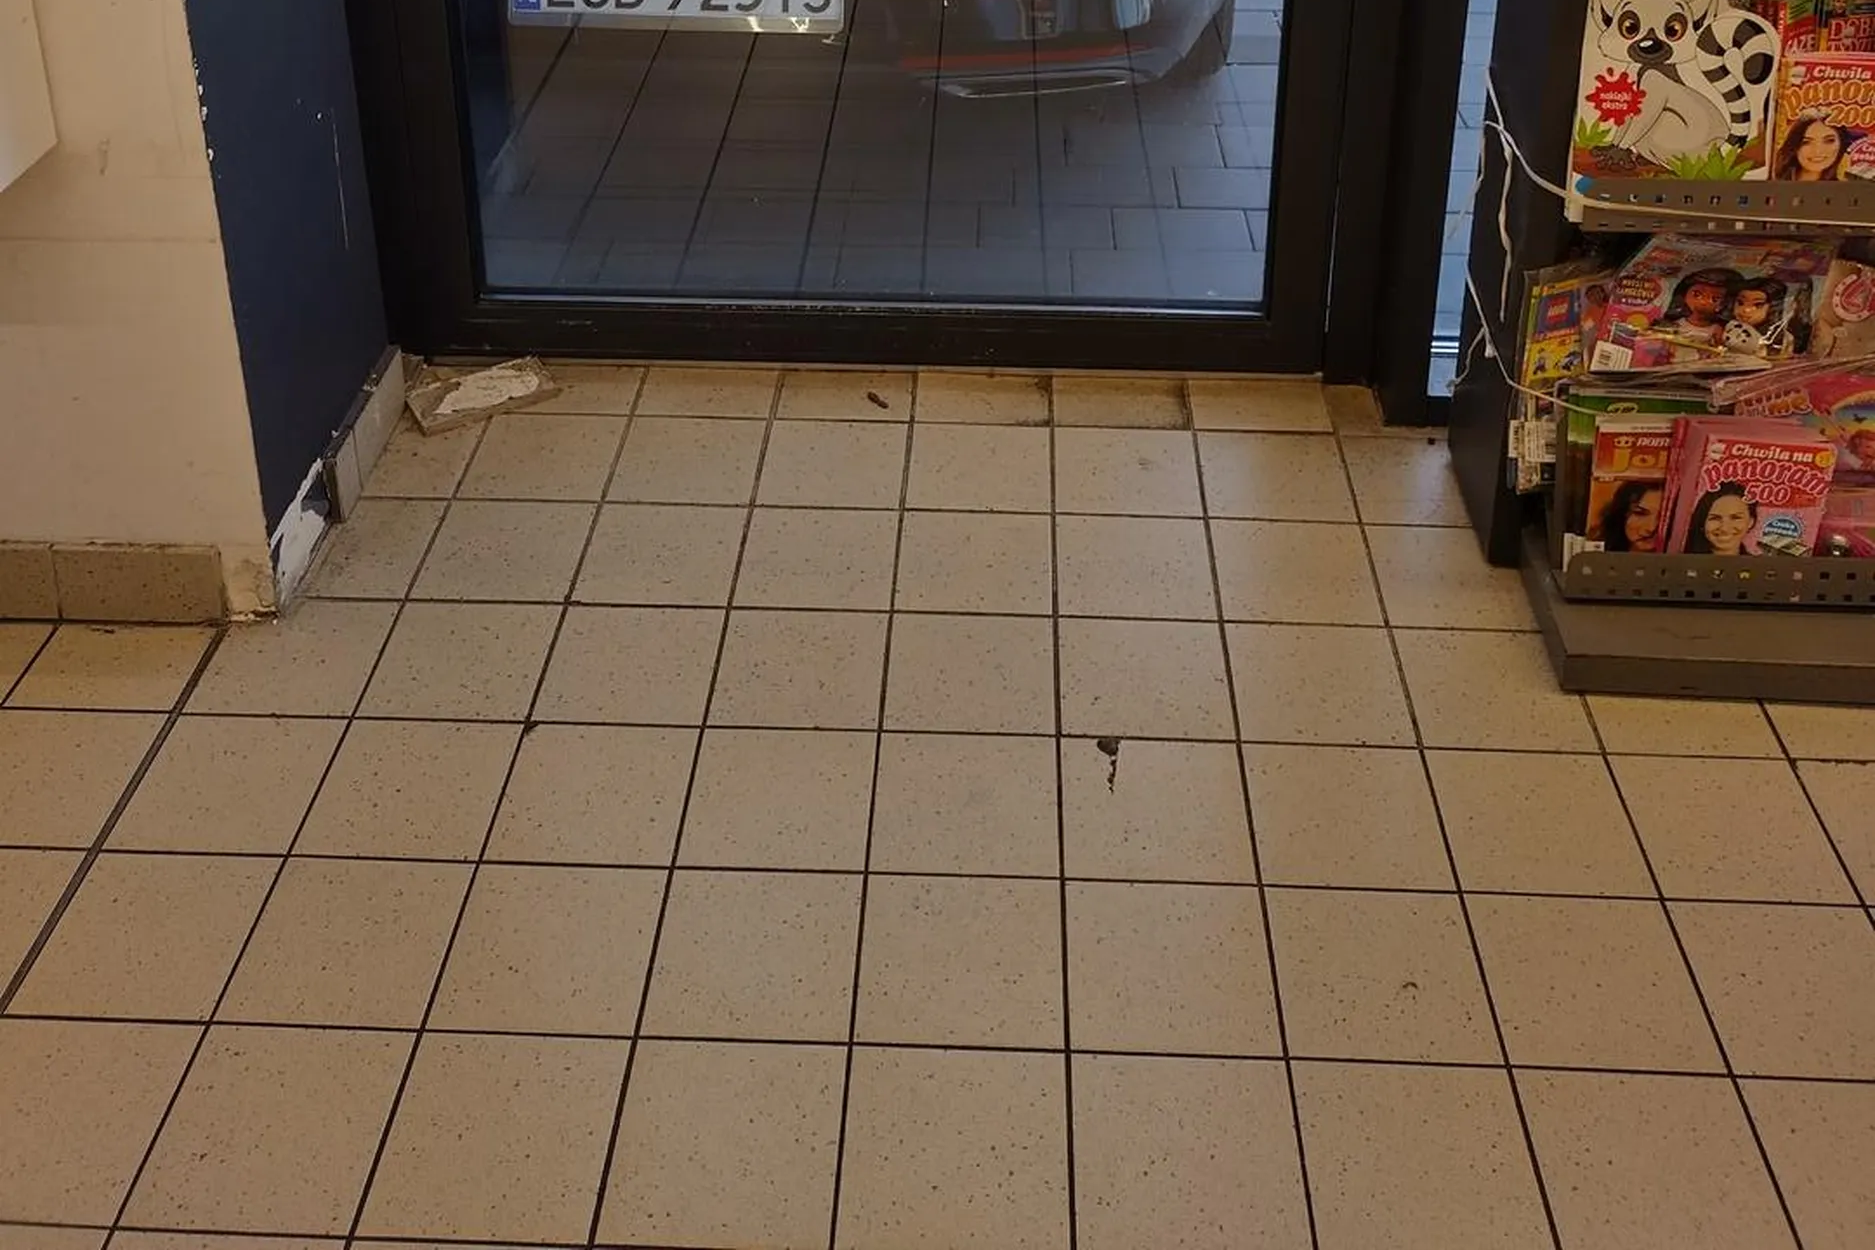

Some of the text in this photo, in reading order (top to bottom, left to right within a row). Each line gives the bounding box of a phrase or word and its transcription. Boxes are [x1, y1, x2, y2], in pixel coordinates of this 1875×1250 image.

[1812, 65, 1873, 79] Chwila
[1732, 444, 1813, 463] Chwila na
[1743, 481, 1791, 504] 500
